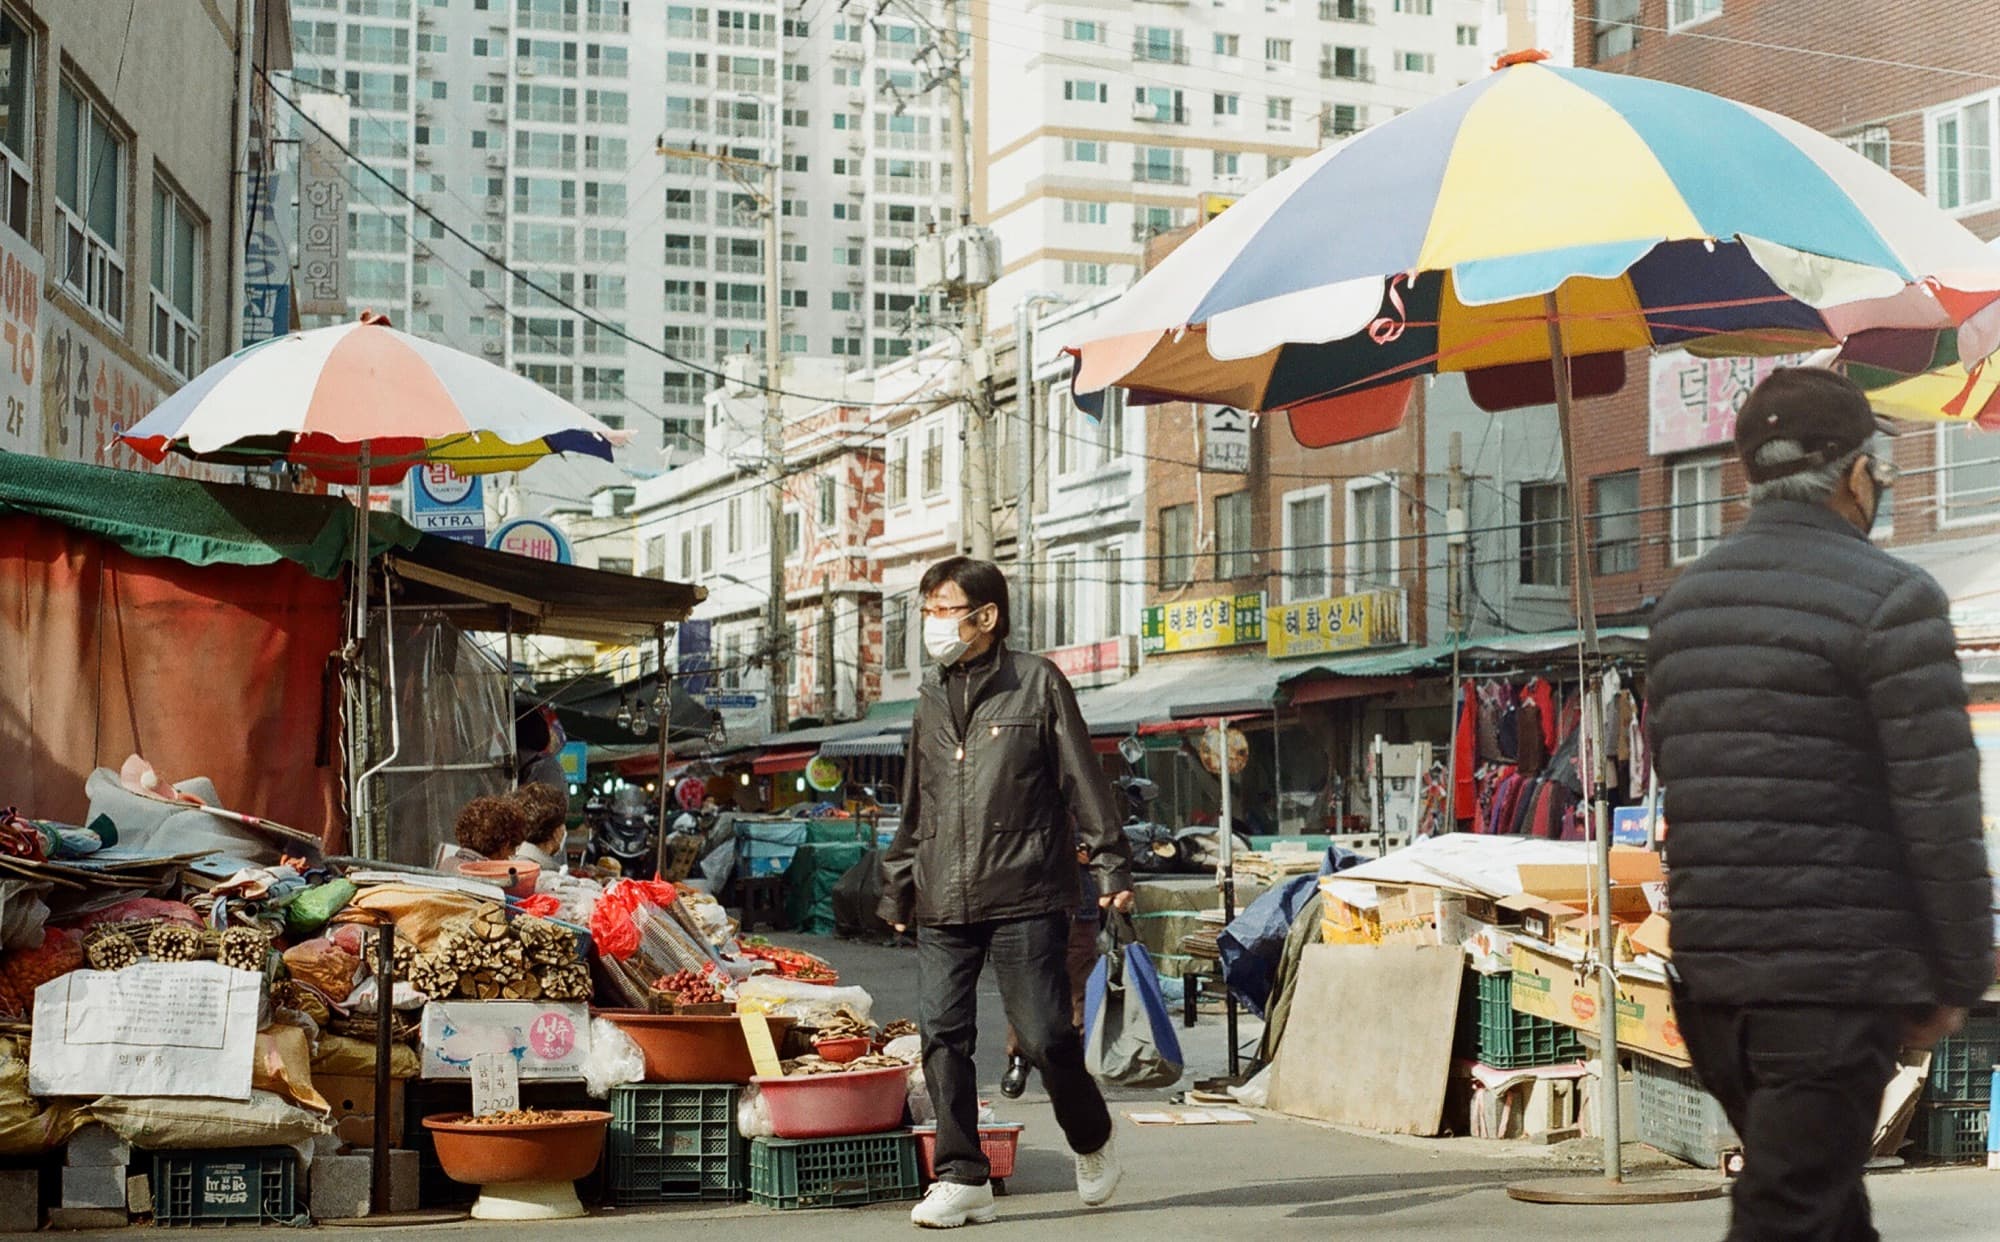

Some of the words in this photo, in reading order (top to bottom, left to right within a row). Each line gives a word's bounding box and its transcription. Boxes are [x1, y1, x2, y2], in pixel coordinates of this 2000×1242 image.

[306, 181, 342, 299] 한의원
[6, 396, 24, 438] 2F
[1212, 406, 1245, 432] 소
[427, 516, 474, 528] KTRA
[1169, 600, 1231, 632] 혜화상회
[1286, 600, 1364, 636] 혜화상사
